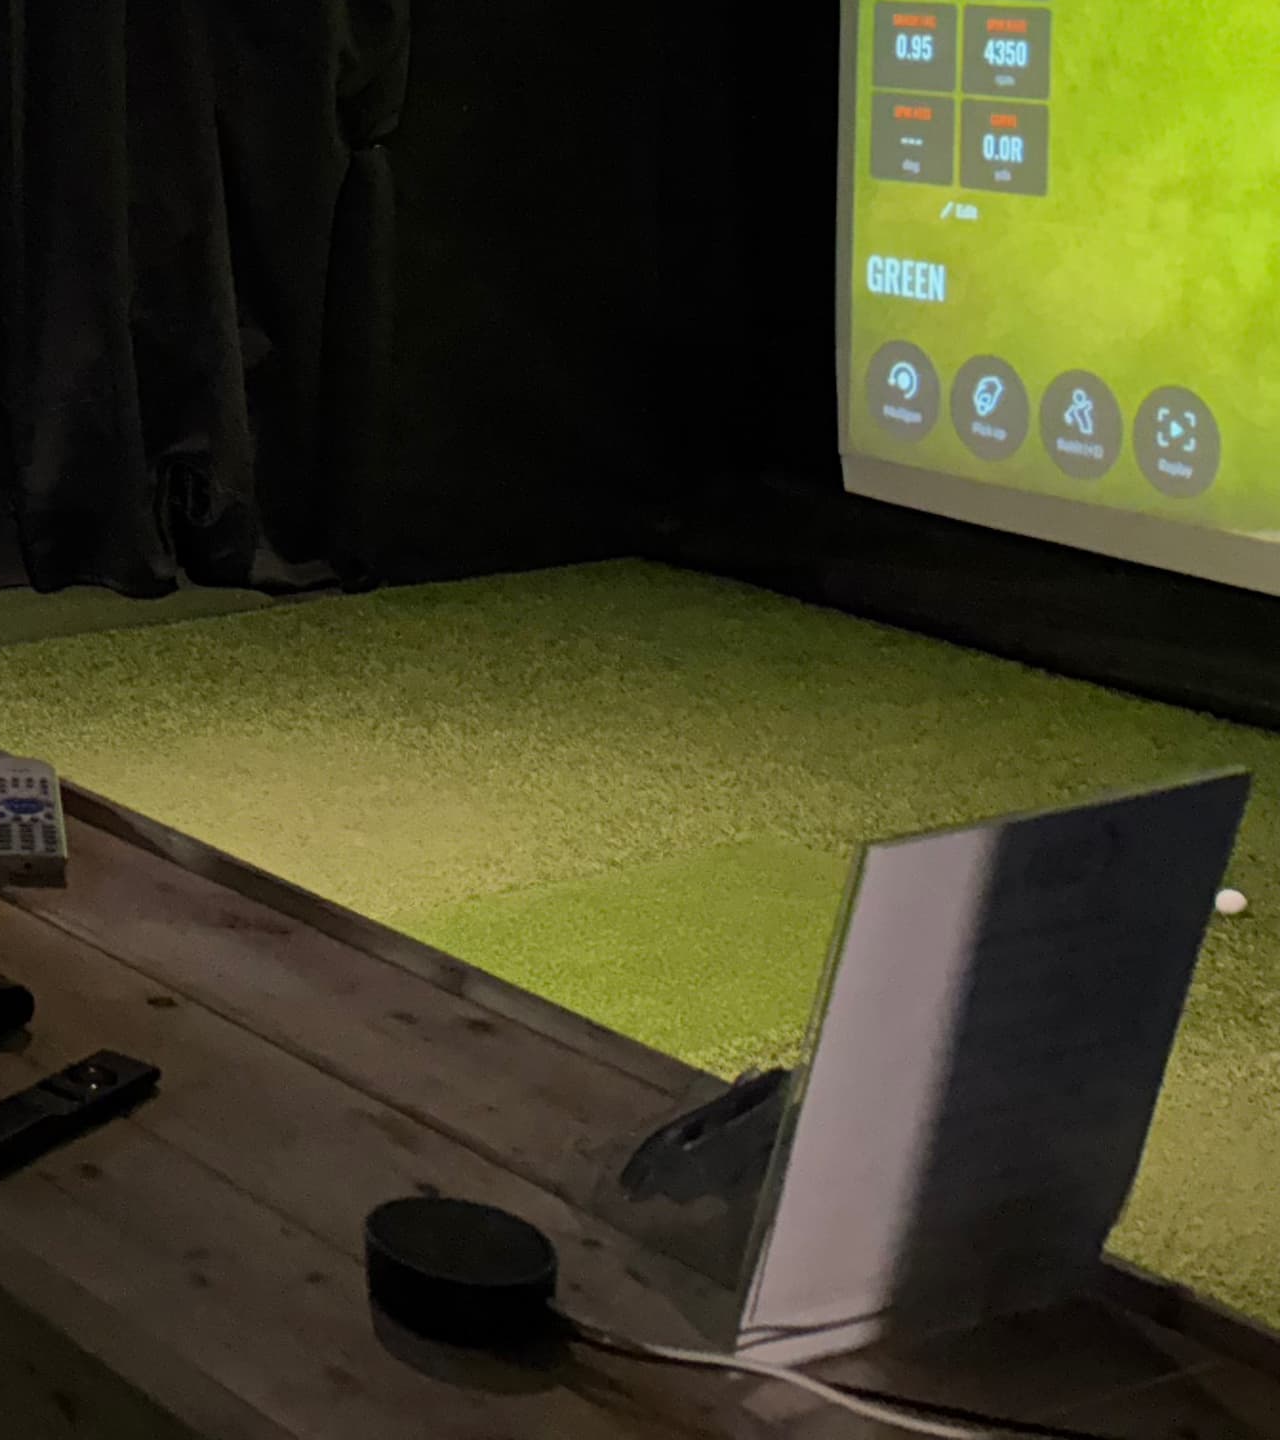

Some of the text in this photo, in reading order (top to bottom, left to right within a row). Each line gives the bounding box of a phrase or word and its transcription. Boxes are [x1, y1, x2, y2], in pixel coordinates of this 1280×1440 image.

[895, 33, 934, 61] 0.95
[983, 39, 1029, 68] 4350
[983, 133, 1024, 163] 0.0R
[867, 254, 946, 302] GREEN
